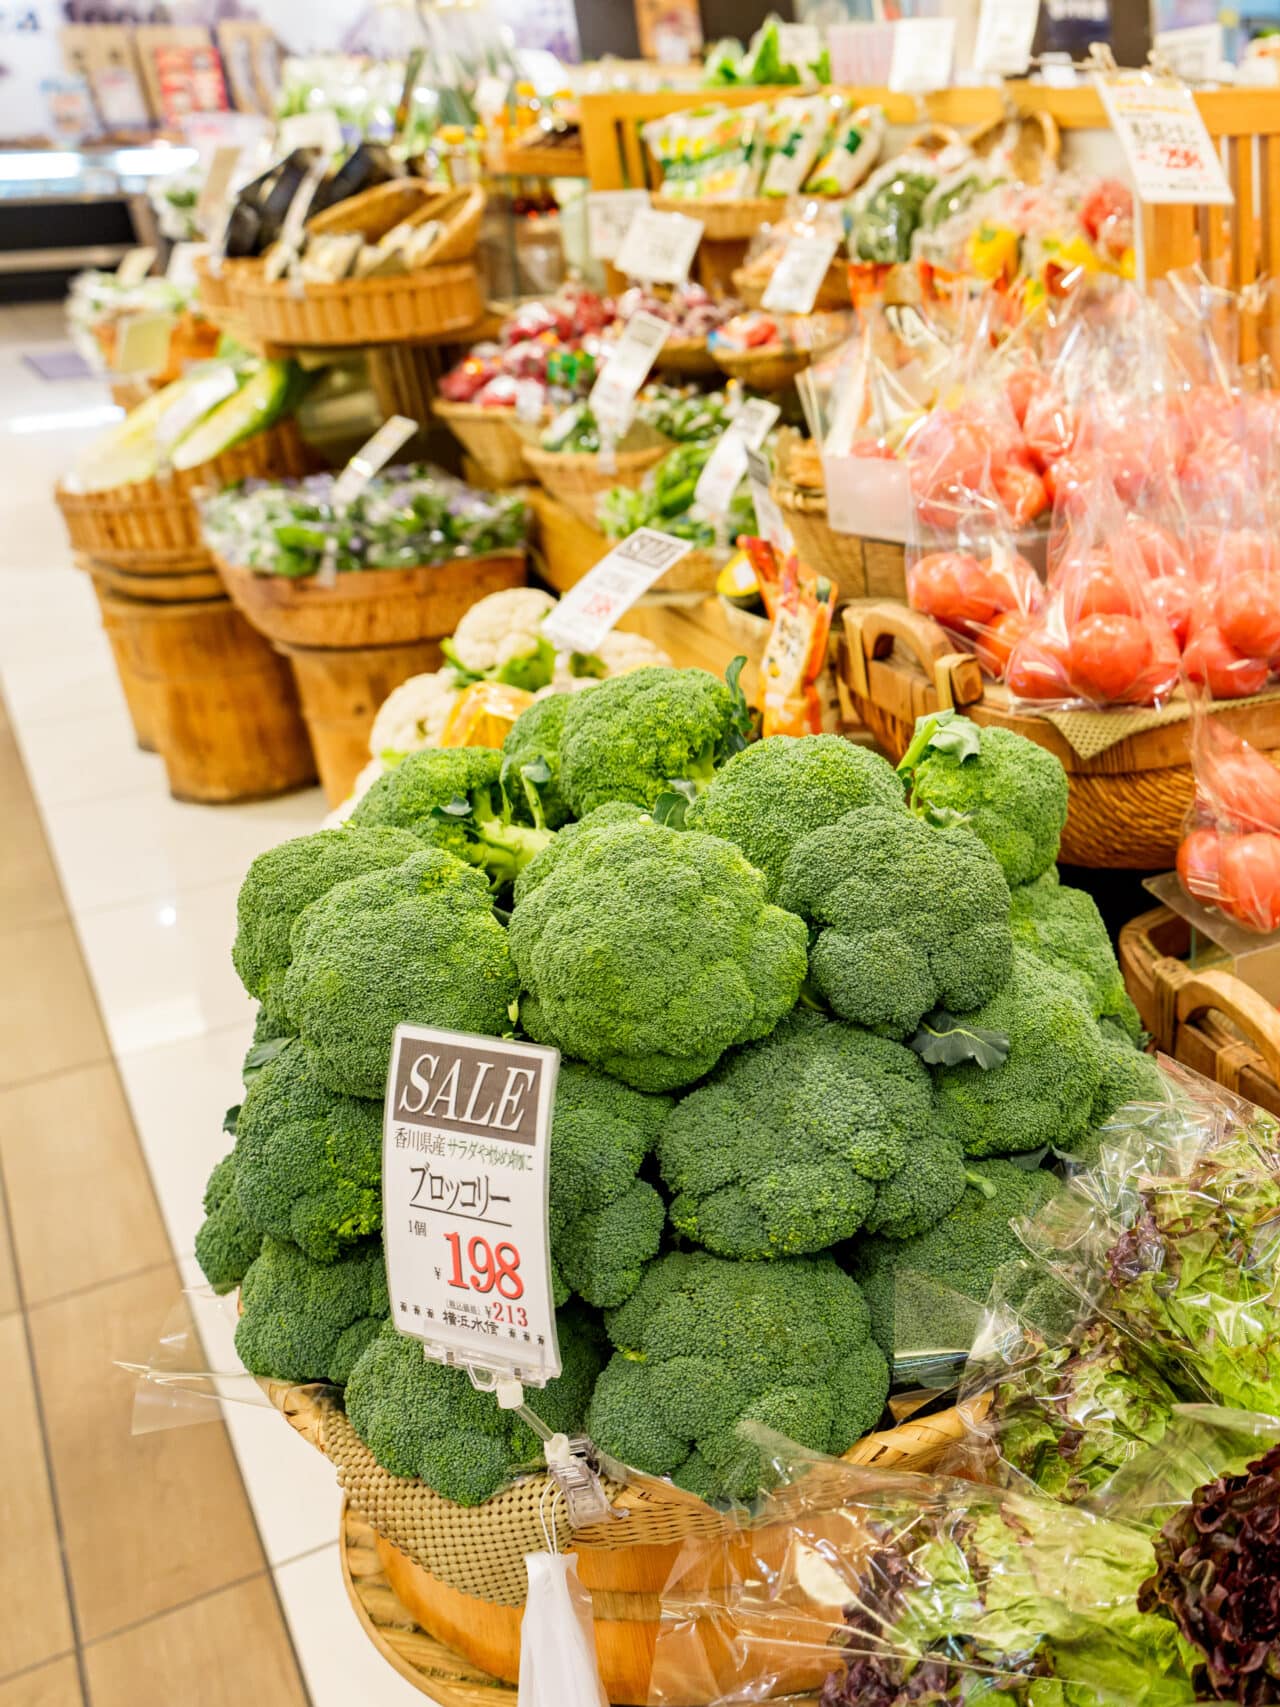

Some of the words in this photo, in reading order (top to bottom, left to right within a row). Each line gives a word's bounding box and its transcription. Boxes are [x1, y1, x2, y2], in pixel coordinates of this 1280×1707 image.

[399, 1053, 535, 1133] SALE
[394, 1127, 446, 1157] 香川県産
[409, 1161, 511, 1219] ブロッコリー
